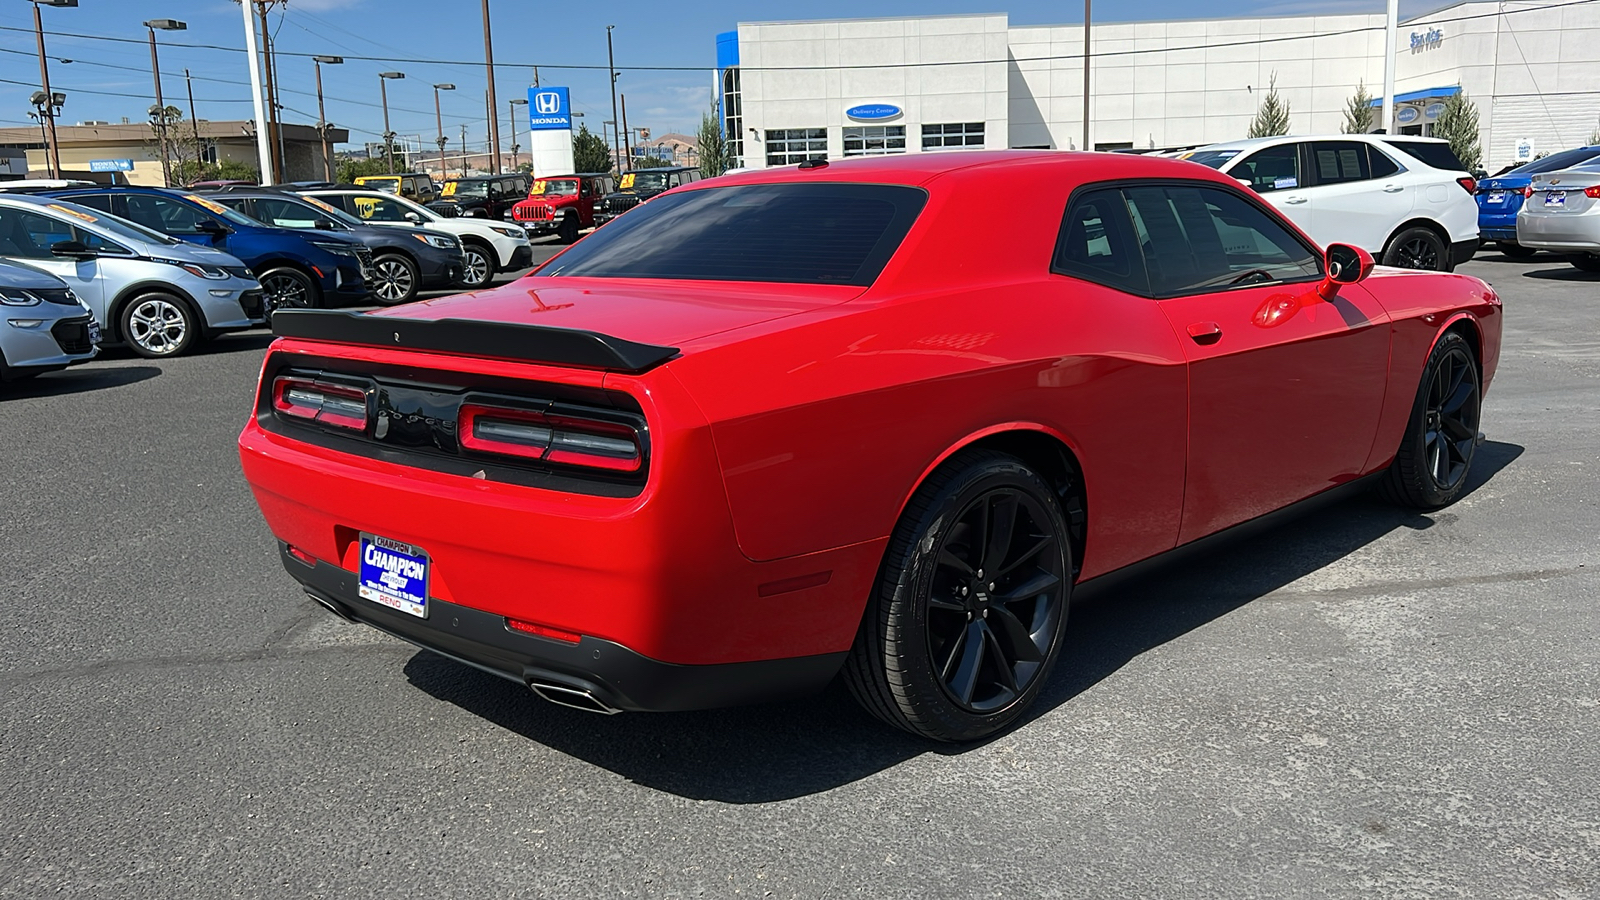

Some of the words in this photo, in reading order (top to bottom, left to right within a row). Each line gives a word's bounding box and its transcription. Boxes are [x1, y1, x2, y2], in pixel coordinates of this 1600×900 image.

[1410, 27, 1443, 49] Service
[377, 538, 409, 553] CHAMPION
[365, 544, 424, 581] CHAMPION
[382, 573, 405, 585] CHEVROLET
[380, 595, 401, 608] RENO
